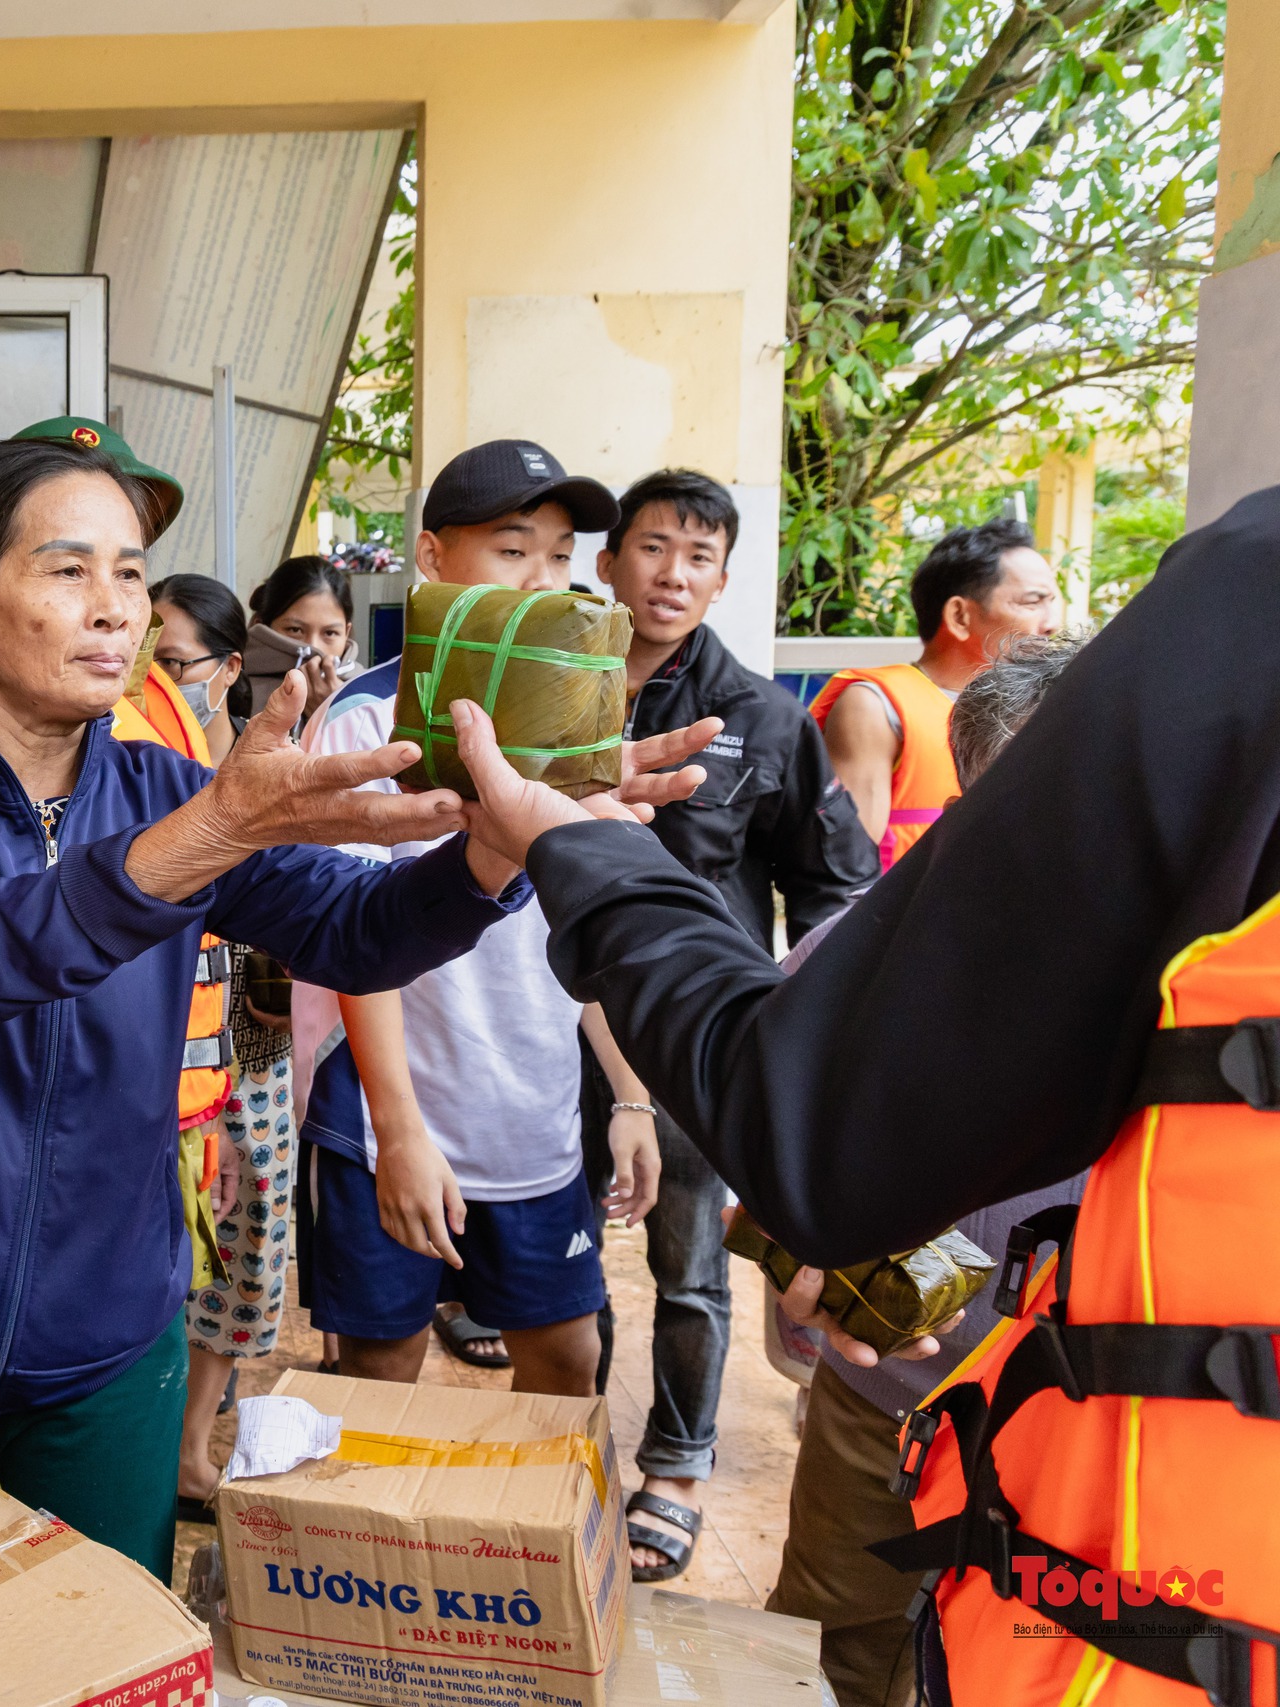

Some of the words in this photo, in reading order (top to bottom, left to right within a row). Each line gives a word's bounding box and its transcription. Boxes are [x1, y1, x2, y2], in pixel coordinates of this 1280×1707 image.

[237, 1539, 268, 1552] Since
[305, 1525, 338, 1540] CÔNG
[339, 1529, 352, 1541] TY
[408, 1538, 441, 1553] BÁNH
[444, 1543, 469, 1557] KẸO
[264, 1563, 422, 1615] LƯƠNG
[434, 1588, 542, 1627] KHÔ
[413, 1626, 451, 1647] ĐẶC
[457, 1630, 499, 1648] BIỆT
[505, 1635, 558, 1654] NGON
[171, 1661, 196, 1681] Quy
[247, 1649, 263, 1662] ĐỊA
[286, 1655, 302, 1668] 15
[306, 1658, 339, 1675] MẠC
[341, 1663, 366, 1682] THỊ
[410, 1677, 428, 1687] HAI
[430, 1677, 444, 1689] BÀ
[446, 1681, 486, 1695] TRƯNG,
[488, 1684, 504, 1696] HÀ
[506, 1687, 529, 1700] NỘI,
[531, 1690, 554, 1704] VIỆT
[556, 1696, 583, 1707] NAM
[335, 1652, 364, 1665] CÔNG
[365, 1657, 378, 1667] TY
[429, 1663, 459, 1677] BÁNH
[462, 1669, 483, 1681] KẸO
[133, 1674, 167, 1697] cách:
[302, 1672, 321, 1683] Điện
[348, 1679, 377, 1692] (84-24)
[423, 1690, 460, 1703] Hotline:
